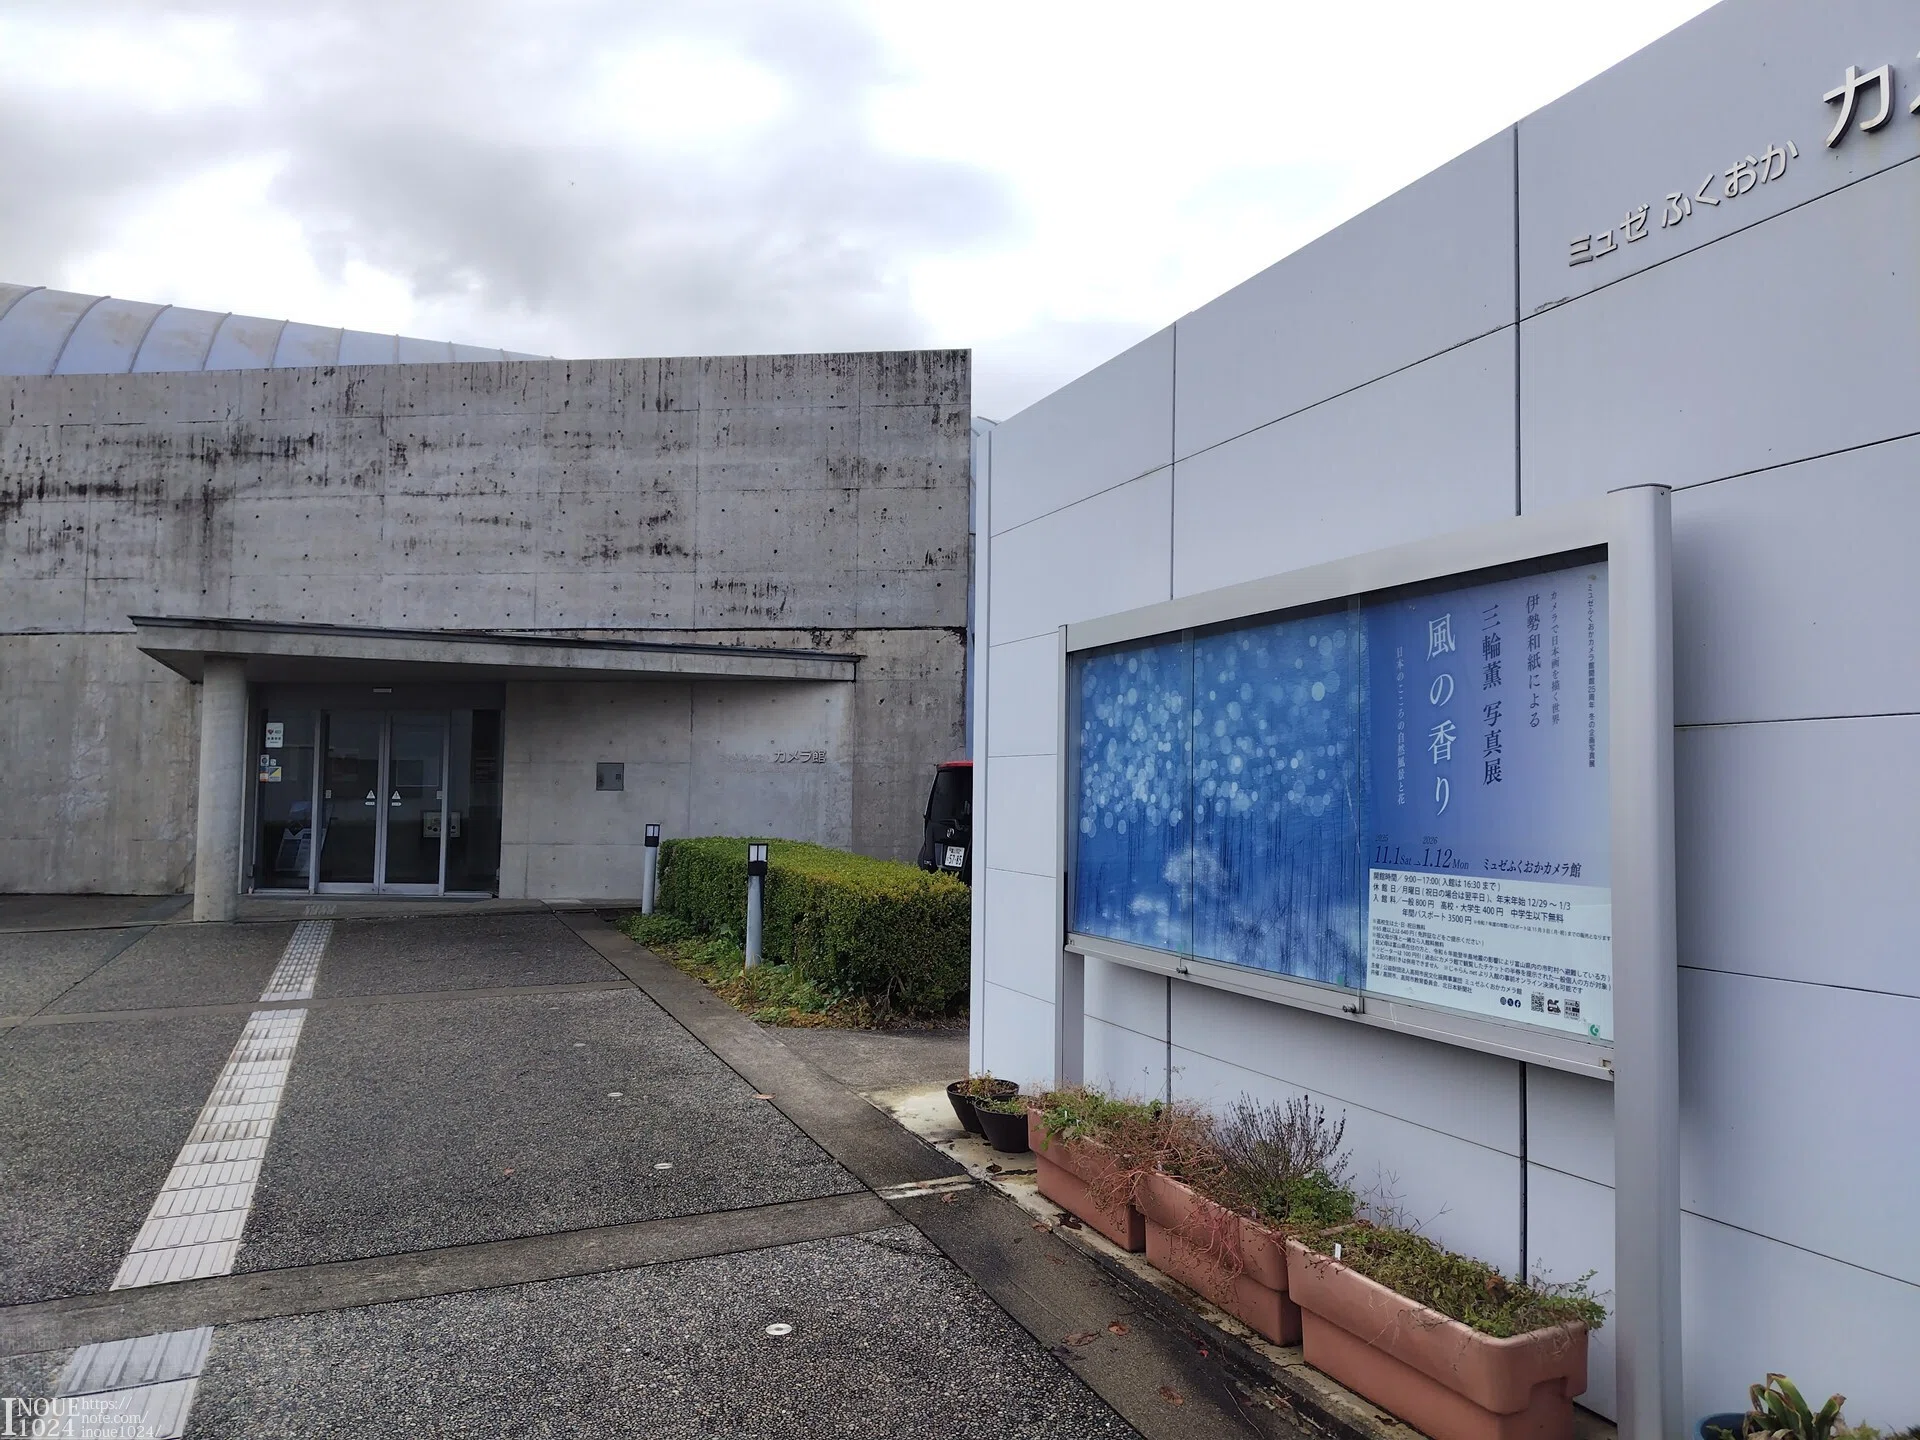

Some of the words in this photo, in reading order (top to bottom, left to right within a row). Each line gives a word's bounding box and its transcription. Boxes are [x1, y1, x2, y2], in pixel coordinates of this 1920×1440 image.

[1569, 202, 1650, 267] ミュゼ
[1661, 139, 1799, 228] ふくおか
[1822, 50, 1920, 149] カ
[1526, 593, 1542, 728] 伊勢和紙による
[1426, 612, 1457, 817] 風の香り
[773, 749, 828, 764] カメラ館
[1482, 700, 1503, 786] 写真展
[1374, 845, 1401, 865] 11.1
[1422, 847, 1453, 868] 1.12
[1452, 858, 1469, 870] Mon
[1422, 836, 1438, 845] 2026
[1483, 857, 1582, 879] ミュゼふくおかカメラ館
